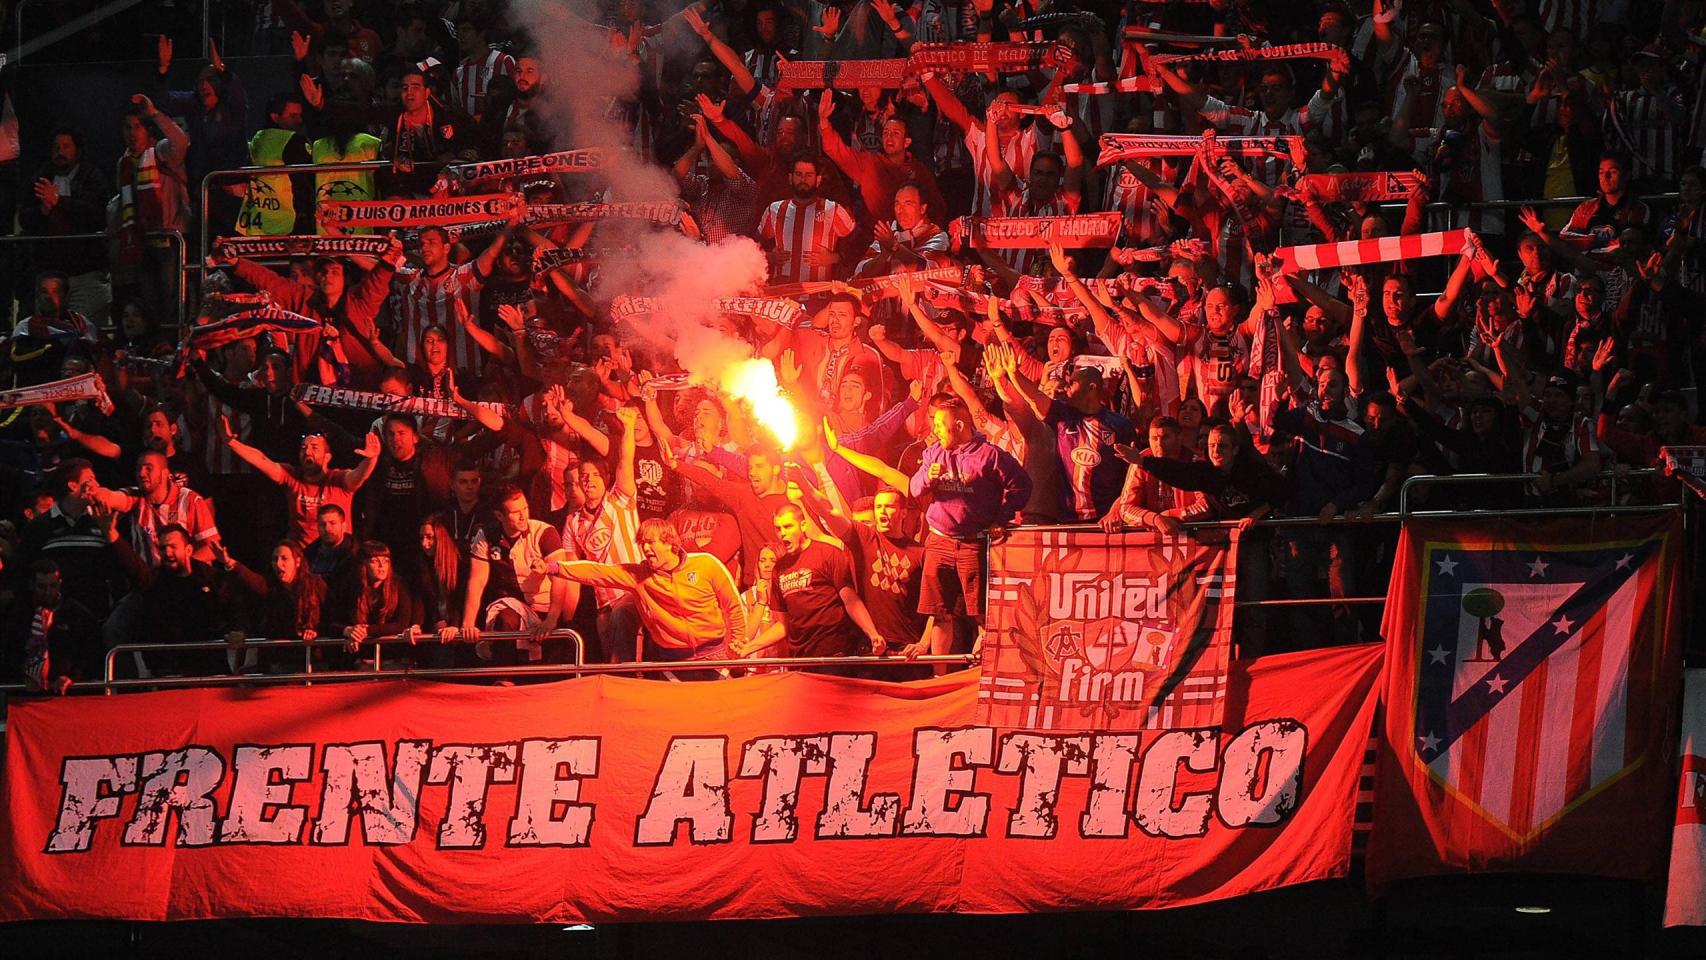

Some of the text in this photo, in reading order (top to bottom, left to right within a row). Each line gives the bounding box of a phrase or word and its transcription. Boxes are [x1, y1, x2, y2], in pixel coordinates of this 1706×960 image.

[973, 50, 988, 61] DE
[462, 152, 599, 180] CAMPEONES
[356, 205, 387, 220] LUIS
[303, 385, 384, 411] FRENTE
[1075, 450, 1097, 464] KIA
[588, 531, 610, 549] KIA
[1049, 573, 1168, 621] United
[44, 717, 1308, 854] FRENTE ATLETICO
